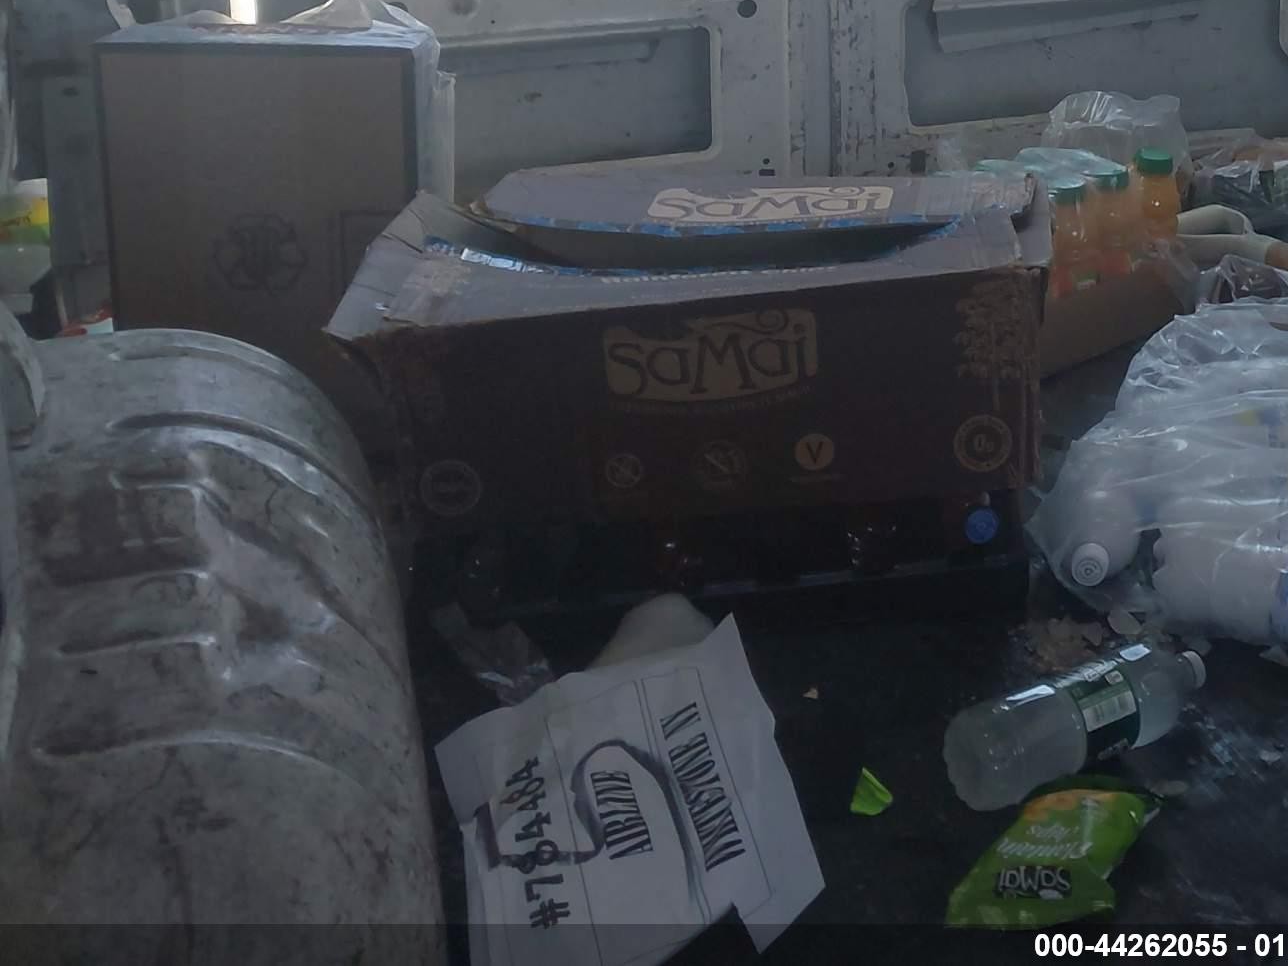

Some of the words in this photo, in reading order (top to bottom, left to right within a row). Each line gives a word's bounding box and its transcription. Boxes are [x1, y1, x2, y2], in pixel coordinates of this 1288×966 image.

[806, 441, 823, 465] V
[659, 701, 702, 741] NY
[589, 769, 655, 860] AIRLINE
